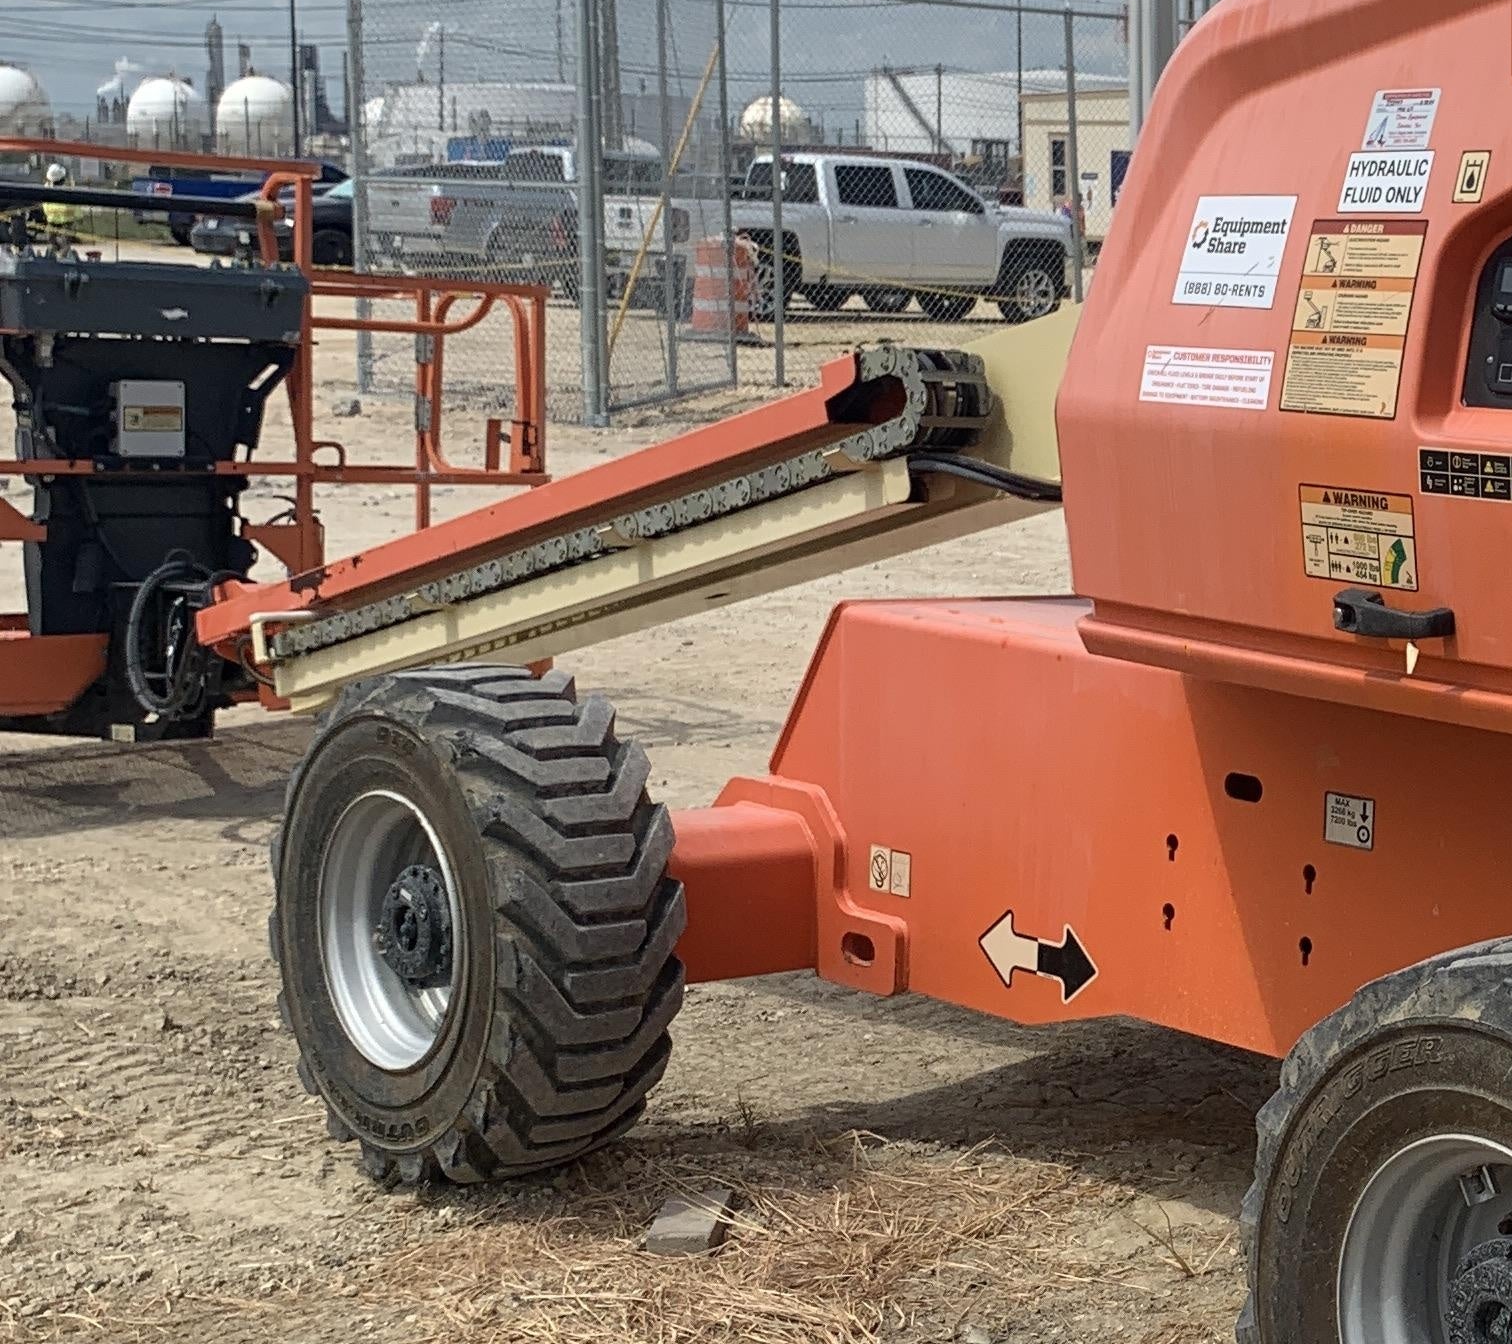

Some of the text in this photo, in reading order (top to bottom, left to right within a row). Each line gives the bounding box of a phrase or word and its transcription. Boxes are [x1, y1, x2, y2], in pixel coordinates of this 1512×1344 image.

[1349, 159, 1429, 177] HYDRAULIC
[1343, 186, 1424, 204] FLUID ONLY
[1212, 216, 1287, 237] Equipment
[1350, 223, 1385, 234] DANGER
[1207, 237, 1247, 254] Share
[1184, 280, 1266, 298] (888) 80-RENTS
[1338, 279, 1377, 290] WARNING
[1328, 335, 1367, 346] WARNING
[1173, 351, 1211, 362] CUSTOMER
[1211, 353, 1272, 365] RESPONSIBILITY
[1332, 491, 1389, 511] WARNING
[1335, 797, 1350, 807] MAX
